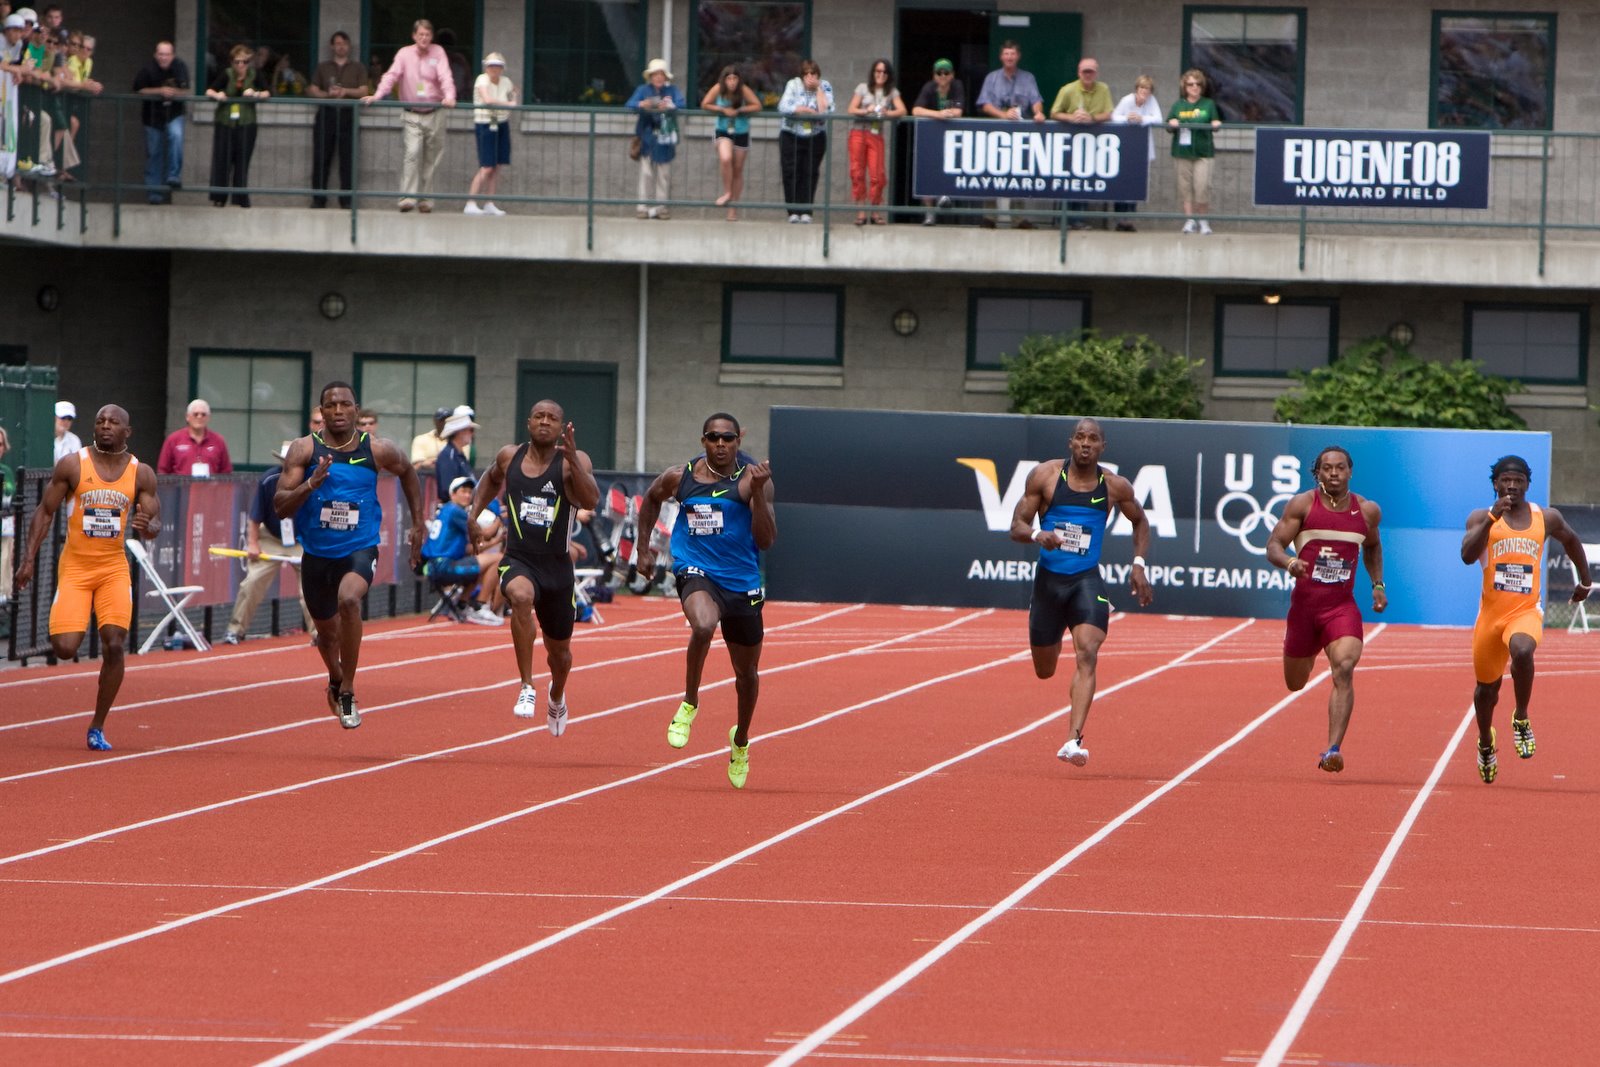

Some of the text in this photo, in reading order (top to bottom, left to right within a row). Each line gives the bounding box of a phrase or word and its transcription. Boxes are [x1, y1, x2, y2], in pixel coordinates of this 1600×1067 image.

[943, 130, 1121, 179] EUGENE08
[1283, 138, 1461, 187] EUGENE08
[956, 176, 1107, 192] HAYWARD FIELD
[1296, 185, 1447, 200] HAYWARD FIELD
[956, 458, 1177, 537] VA
[1063, 531, 1081, 540] MICKEY
[1188, 566, 1252, 589] TEAM
